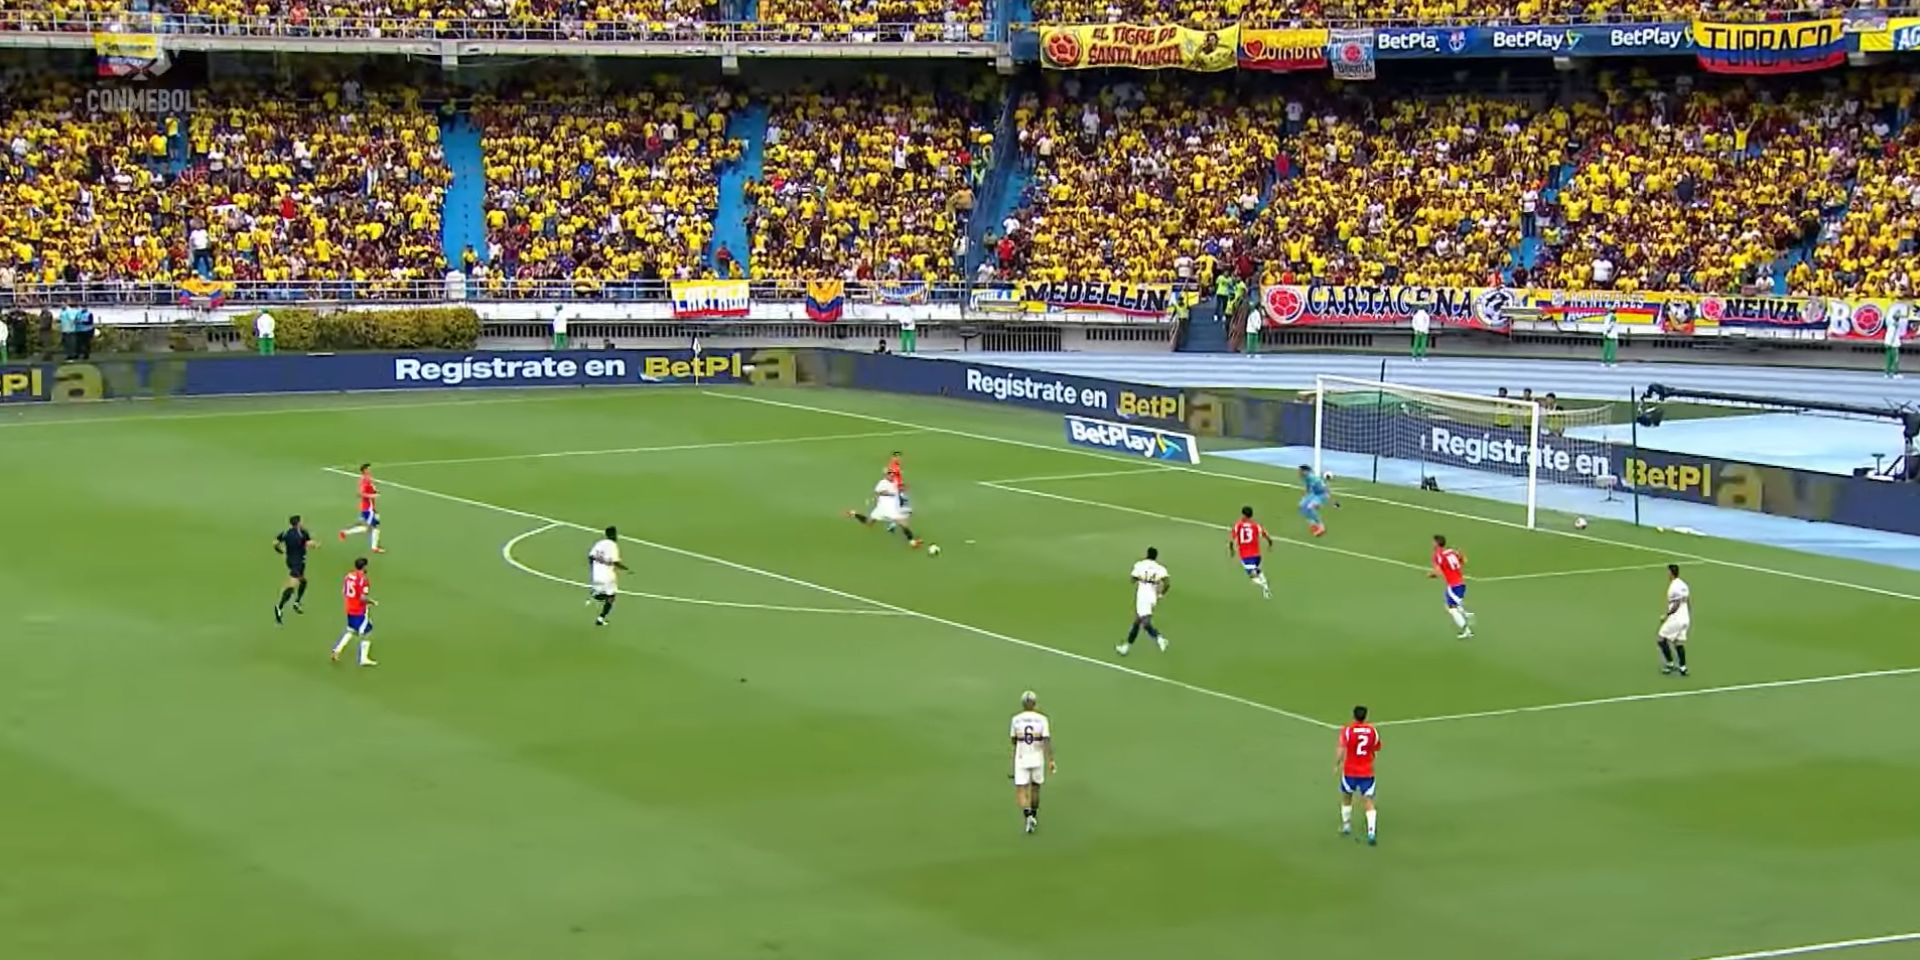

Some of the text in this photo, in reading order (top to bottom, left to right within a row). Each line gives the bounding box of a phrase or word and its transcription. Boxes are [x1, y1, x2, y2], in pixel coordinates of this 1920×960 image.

[1113, 26, 1155, 44] TIGRE
[1379, 32, 1439, 51] BetPla
[1493, 29, 1563, 50] BetPlay
[1610, 28, 1682, 48] BetPlay
[1088, 44, 1184, 65] SANTA MARTA
[1704, 25, 1833, 67] TURBACO
[1021, 282, 1169, 312] MEDELLIN
[1307, 284, 1473, 317] CARTAGENA
[1724, 298, 1801, 319] NEIVA
[395, 356, 578, 384] Regístrate
[585, 358, 626, 377] en
[966, 368, 1077, 404] Regístrate
[1080, 388, 1108, 408] en
[1070, 420, 1156, 457] BetPlay
[1576, 453, 1609, 477] en
[1240, 526, 1254, 544] 13
[346, 579, 357, 598] 15
[1024, 725, 1034, 745] 6
[1356, 734, 1369, 756] 2
